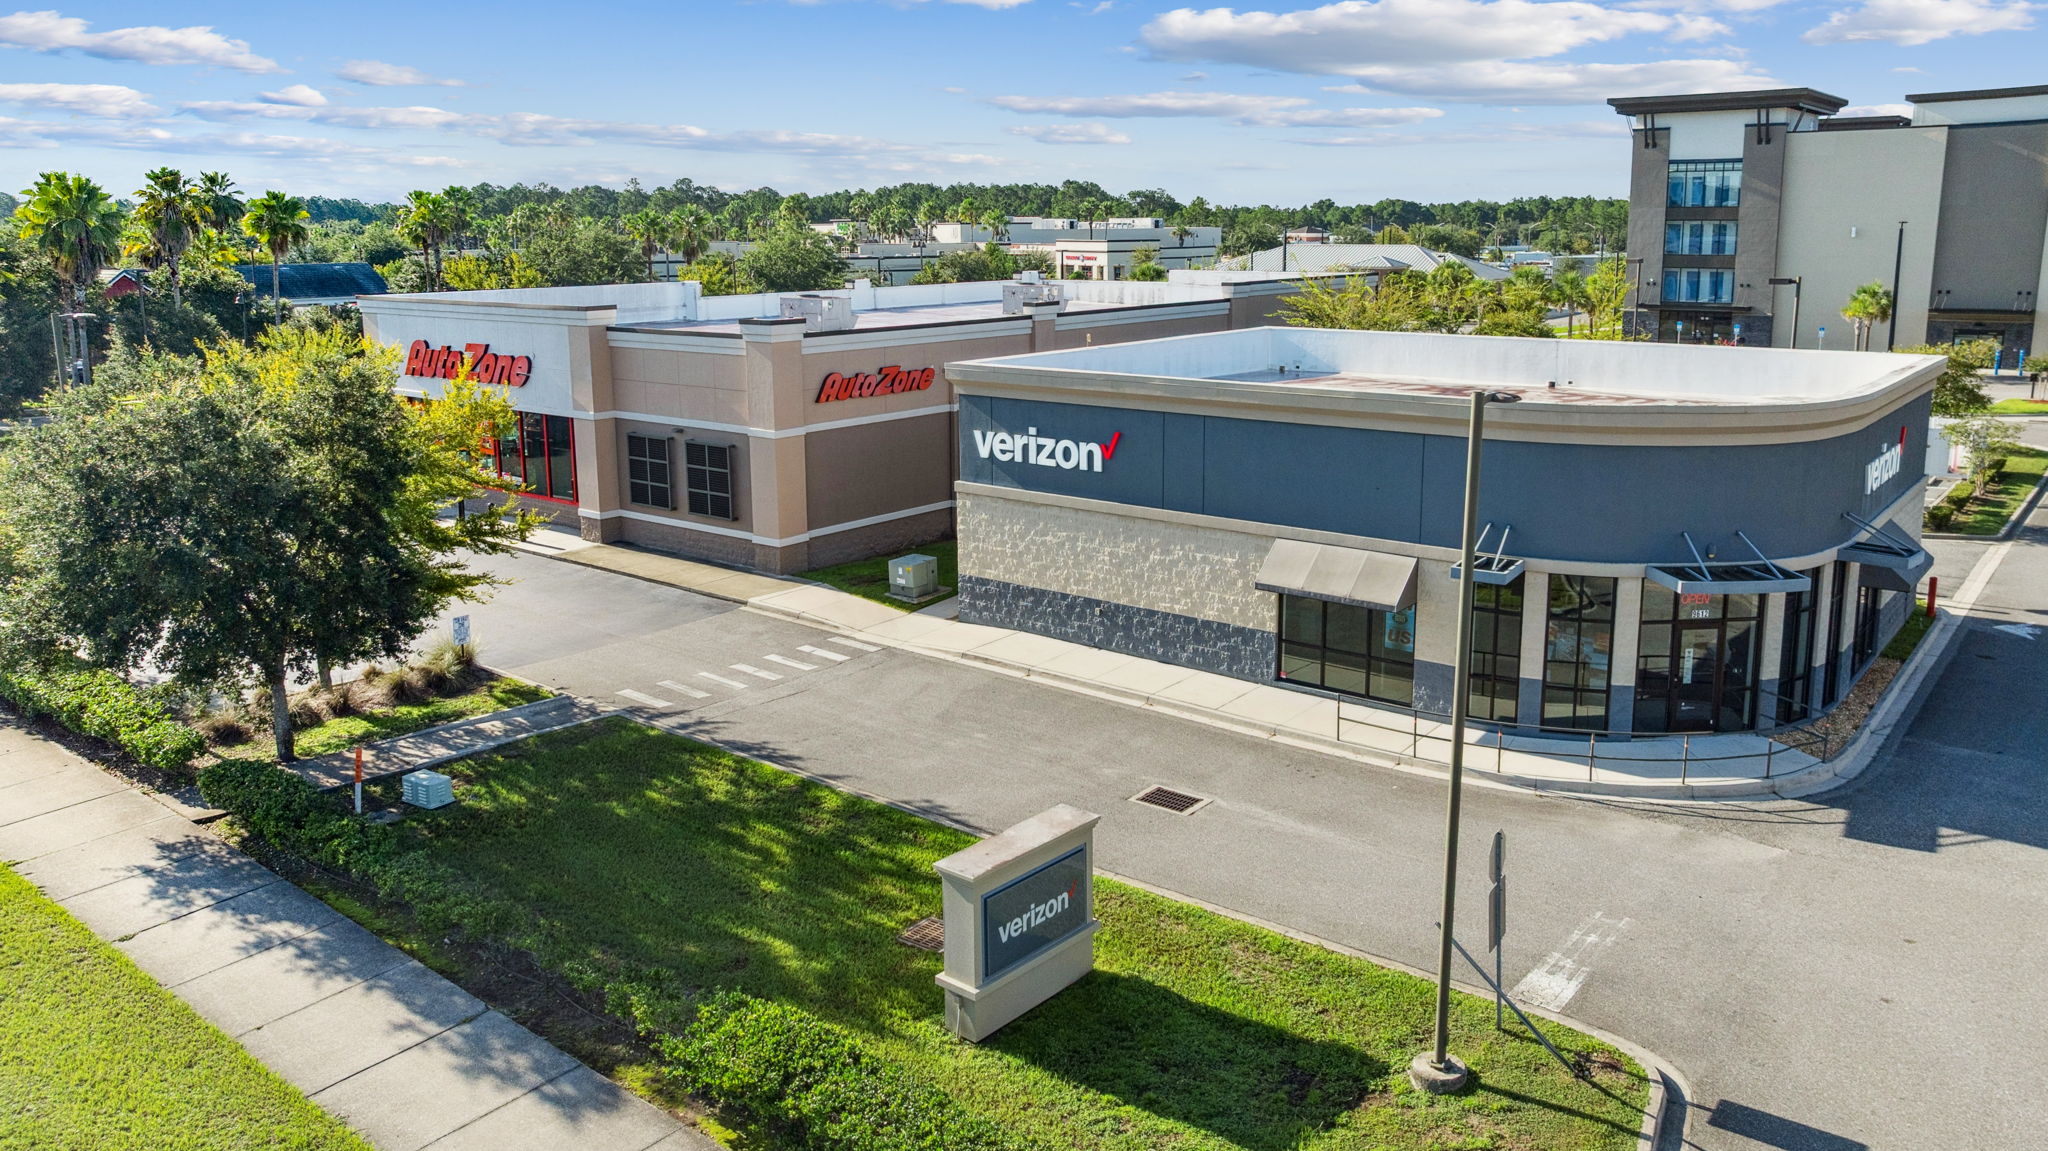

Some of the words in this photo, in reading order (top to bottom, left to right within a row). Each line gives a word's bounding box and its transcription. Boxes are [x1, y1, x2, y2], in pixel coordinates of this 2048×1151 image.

[405, 339, 532, 388] AutoZone
[815, 365, 935, 403] AutoZone
[973, 427, 1103, 472] verizon
[1864, 443, 1901, 495] verizon
[1681, 593, 1710, 604] OPEN
[998, 891, 1069, 944] verizon
